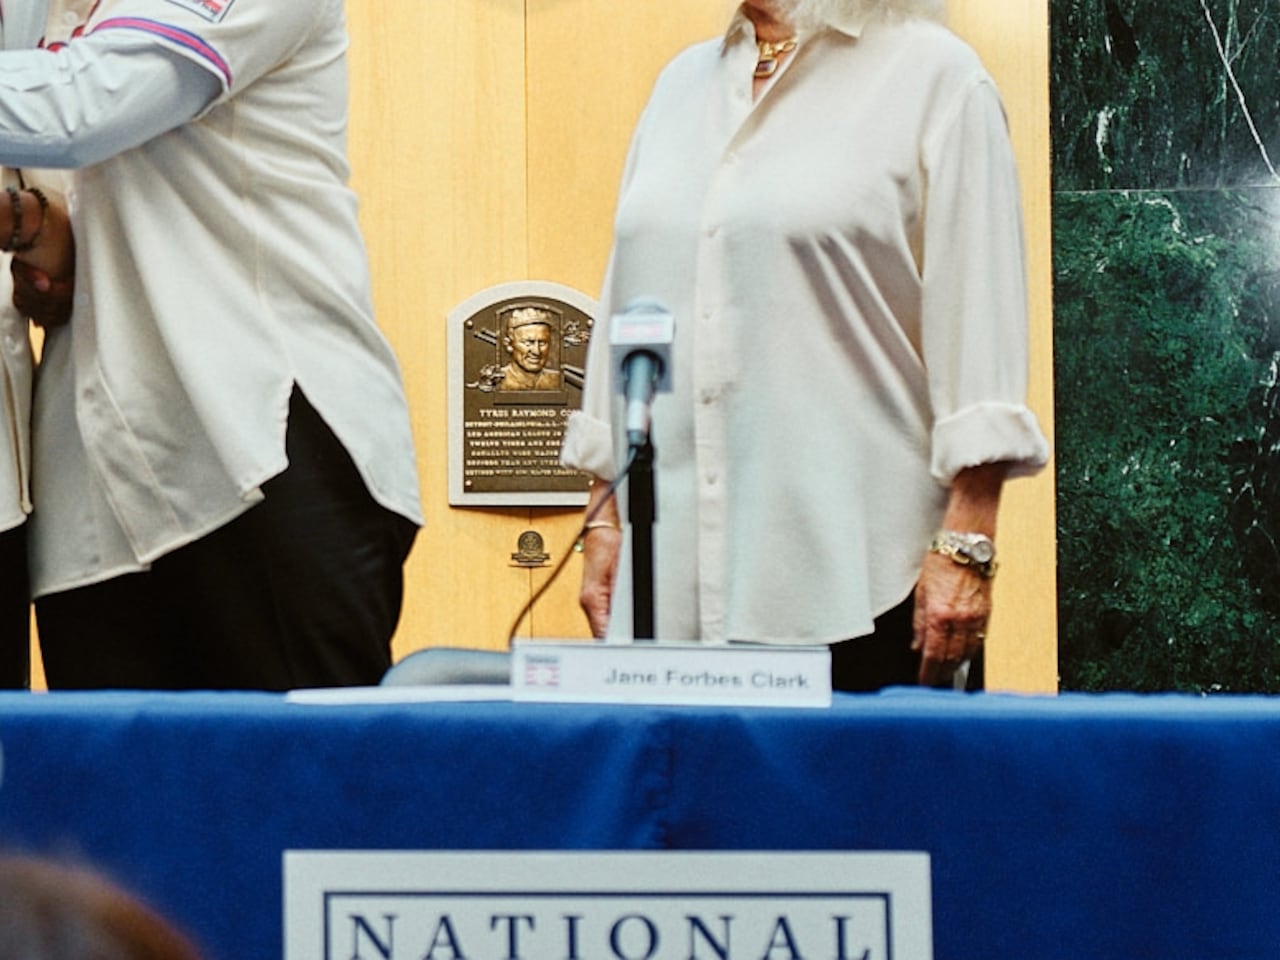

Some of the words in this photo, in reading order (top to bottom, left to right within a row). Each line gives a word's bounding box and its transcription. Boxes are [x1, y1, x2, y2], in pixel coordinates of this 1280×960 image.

[605, 668, 655, 684] Jane
[666, 670, 743, 686] Forbes
[751, 672, 810, 689] Clark
[348, 913, 872, 960] NATIONAL
